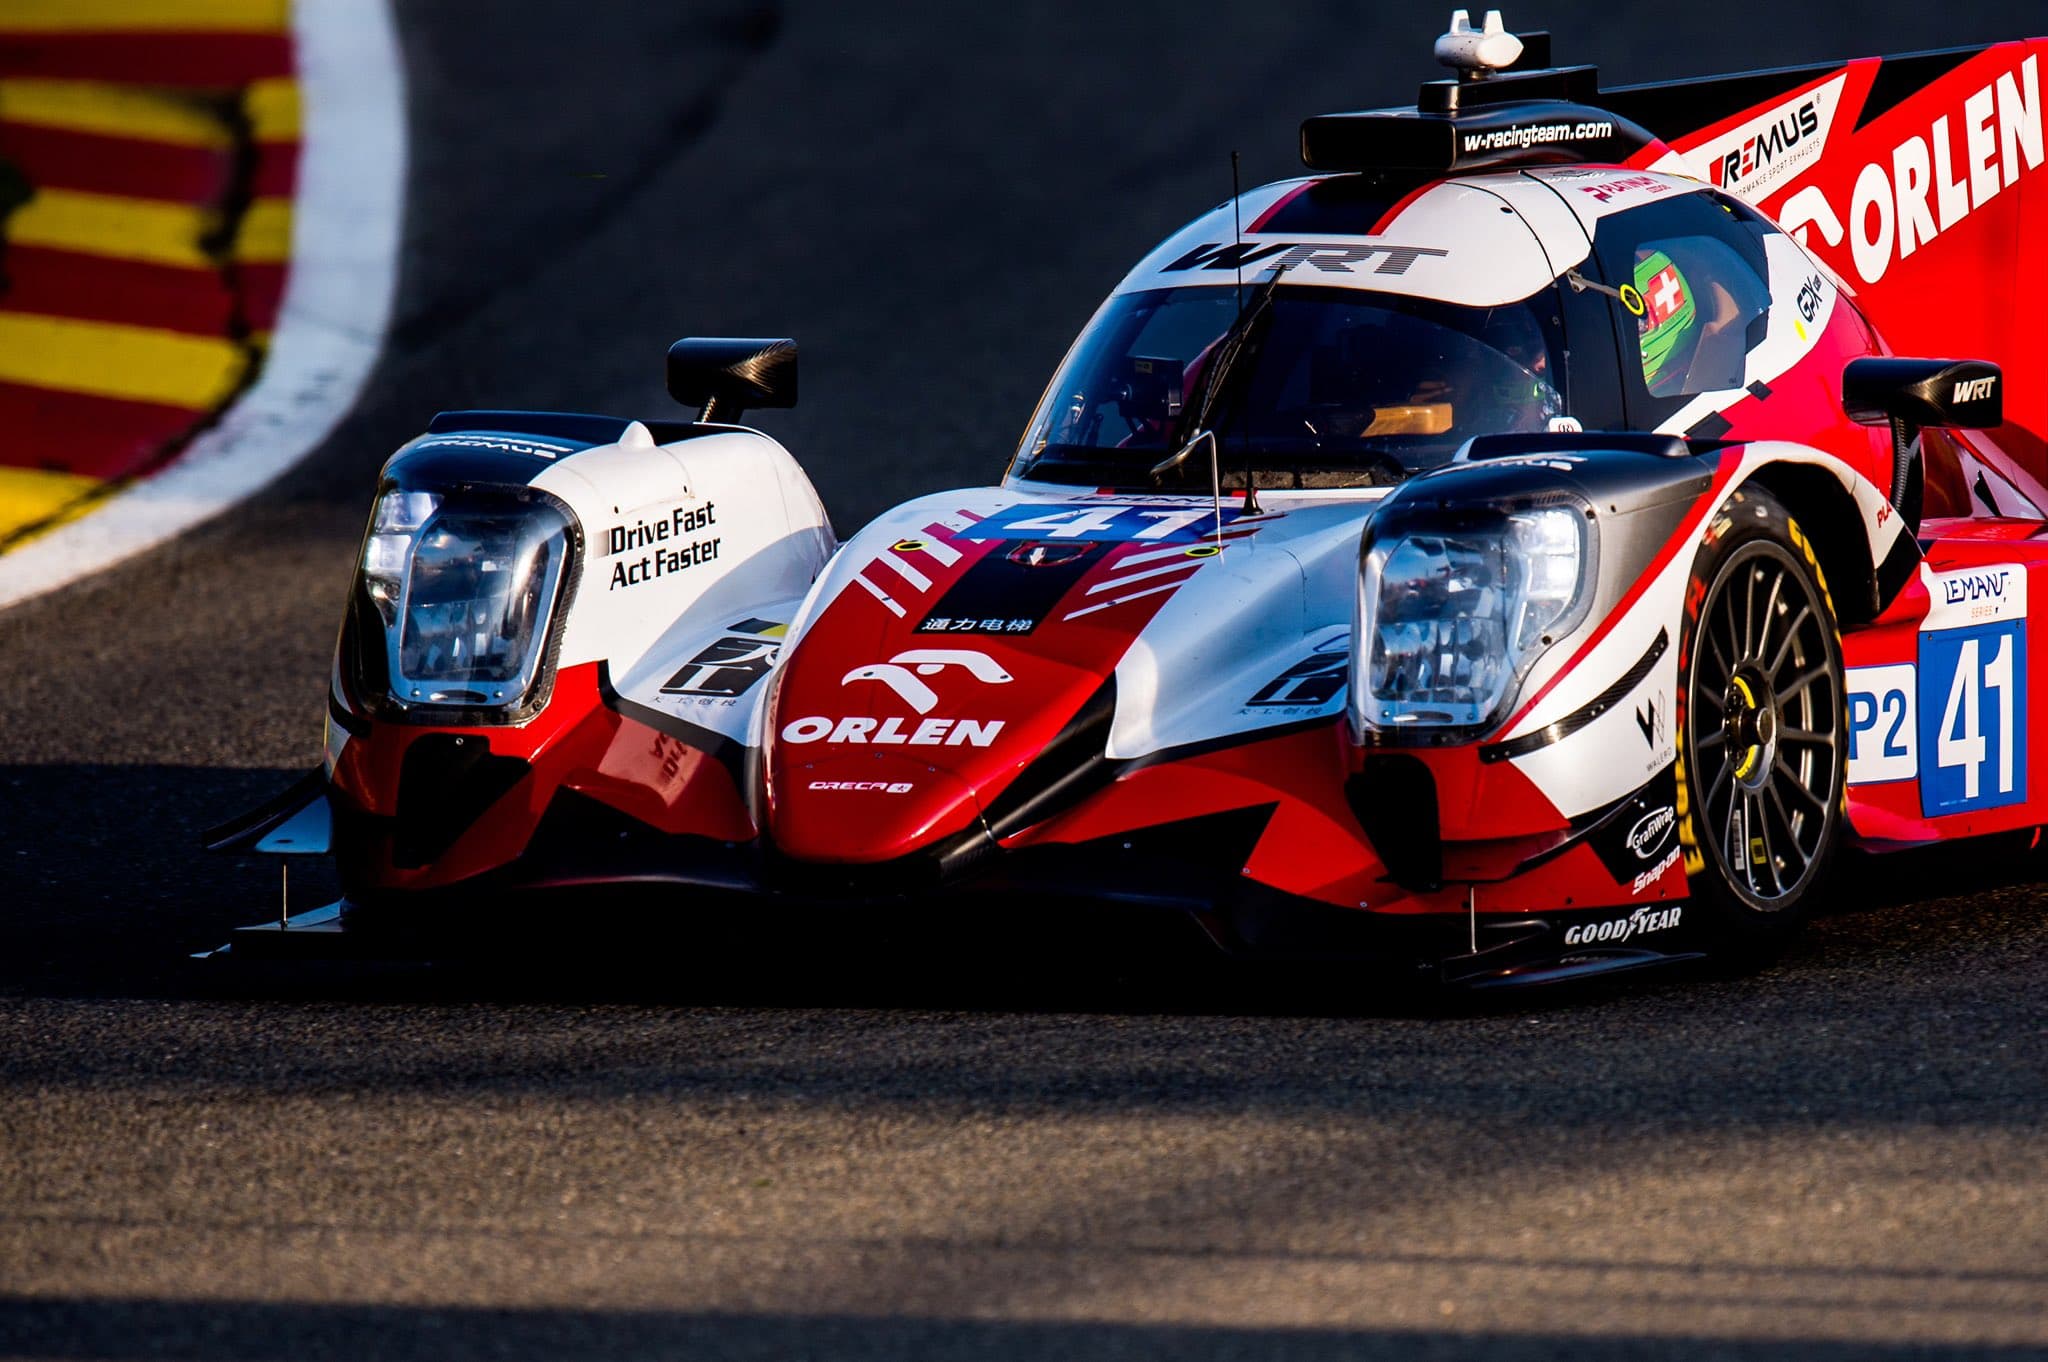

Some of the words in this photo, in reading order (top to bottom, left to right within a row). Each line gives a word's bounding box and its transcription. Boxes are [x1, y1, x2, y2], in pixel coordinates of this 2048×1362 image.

[1465, 122, 1612, 151] w-racingteam.com
[1723, 101, 1818, 189] REMUS
[1850, 53, 2044, 284] ORLEN
[1159, 242, 1449, 275] WRT
[1952, 375, 1996, 404] WRT
[610, 519, 669, 555] Drive
[673, 500, 716, 536] Fast
[1003, 506, 1218, 539] 41
[609, 557, 651, 591] Act
[655, 537, 720, 577] Faster
[921, 616, 1033, 632] 通力电梯
[781, 716, 1006, 747] ORLEN
[1937, 634, 2013, 799] 41
[808, 781, 888, 791] ORECA
[1632, 806, 1674, 849] GrafiWrap
[1632, 845, 1680, 895] Snap-on
[1565, 907, 1682, 945] GOODYEAR
